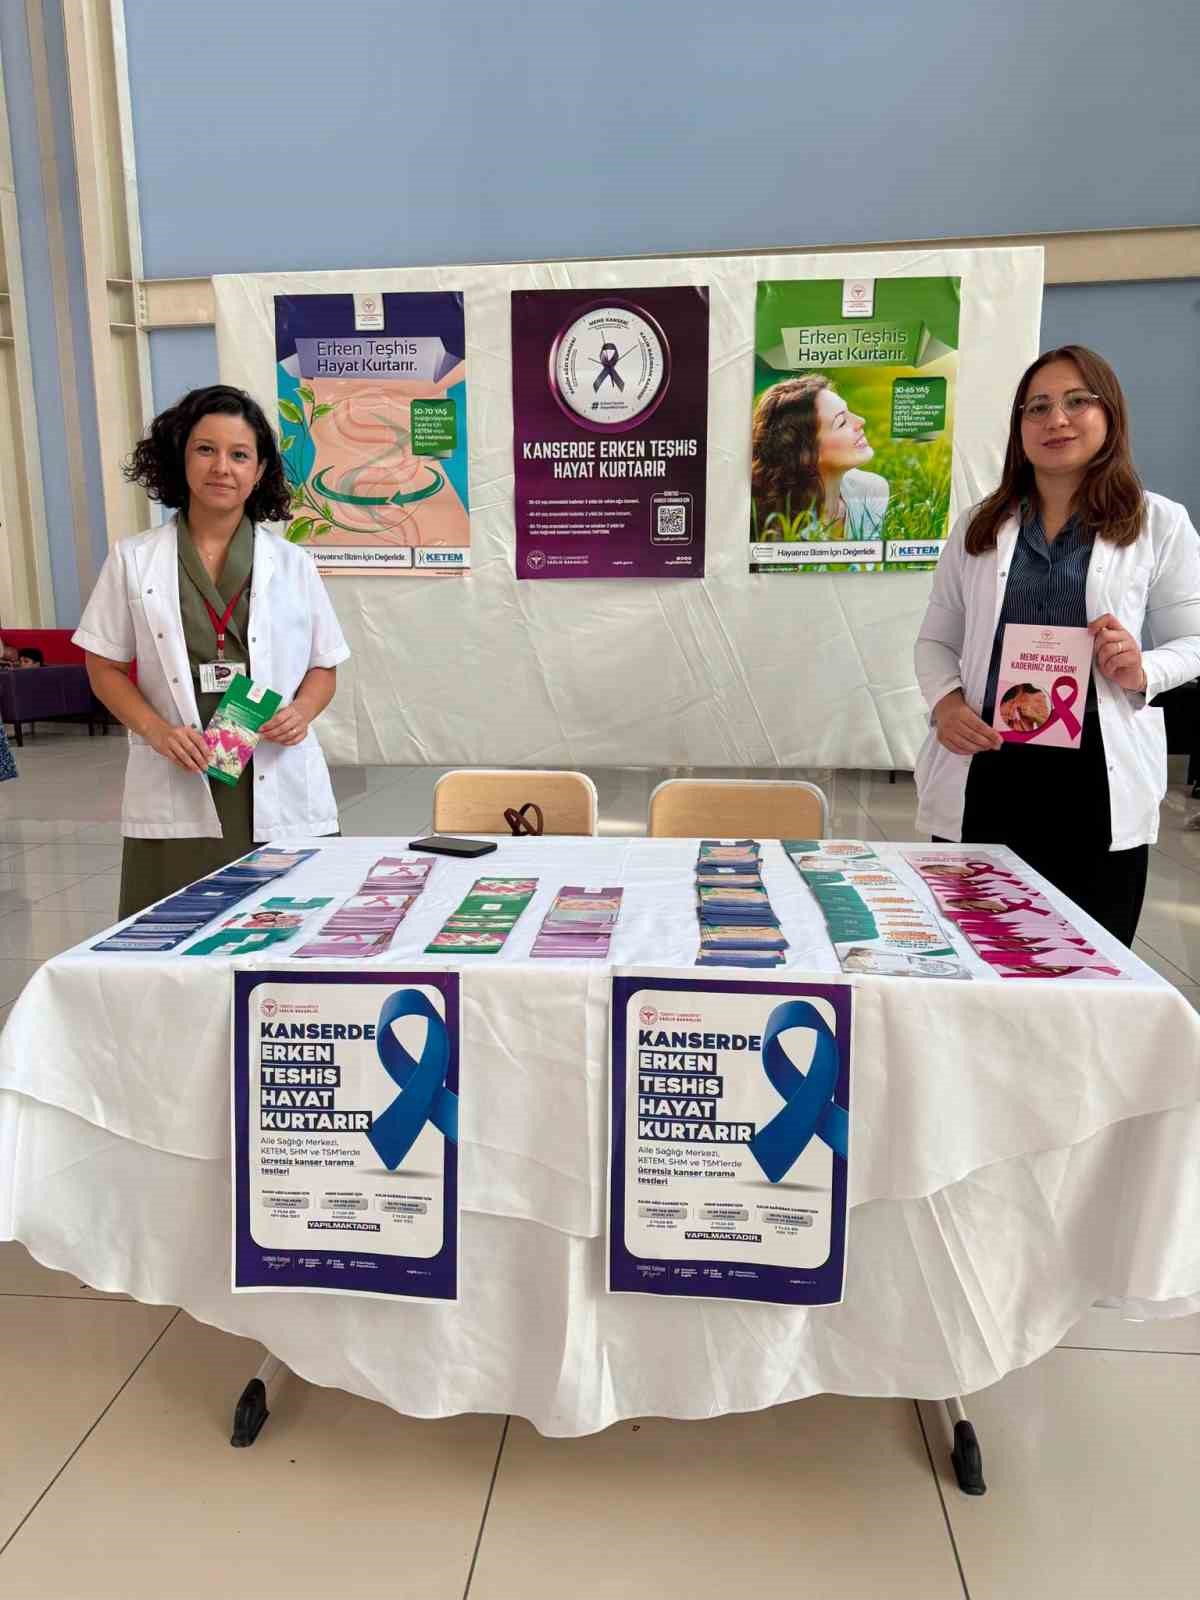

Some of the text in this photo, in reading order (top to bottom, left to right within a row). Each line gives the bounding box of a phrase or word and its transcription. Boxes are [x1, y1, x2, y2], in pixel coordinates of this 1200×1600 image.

[799, 327, 907, 347] Erken Teşhis
[317, 340, 418, 359] Erken Teşhis
[799, 346, 906, 364] Hayat Kurtarır.
[317, 359, 418, 375] Hayat Kurtarır.
[523, 439, 697, 459] KANSERDE ERKEN TEŞHİS
[554, 460, 666, 479] HAYAT KURTARIR
[425, 553, 463, 561] KETEM
[899, 546, 939, 555] KETEM
[1020, 653, 1040, 662] MEME
[261, 1022, 376, 1040] KANSERDE
[638, 1030, 761, 1051] KANSERDE
[262, 1045, 330, 1062] ERKEN
[639, 1053, 713, 1071] ERKEN
[262, 1089, 333, 1107] HAYAT
[639, 1098, 714, 1118] HAYAT
[262, 1112, 370, 1130] KURTARIR
[639, 1120, 752, 1142] KURTARIR
[260, 1137, 275, 1145] Aile
[289, 1148, 308, 1156] SHM
[638, 1146, 653, 1154] Aile
[295, 1158, 323, 1167] kanser
[668, 1157, 687, 1166] SHM
[261, 1167, 290, 1175] testleri
[673, 1168, 703, 1177] kanser
[704, 1169, 735, 1178] tarama
[638, 1176, 668, 1185] testleri
